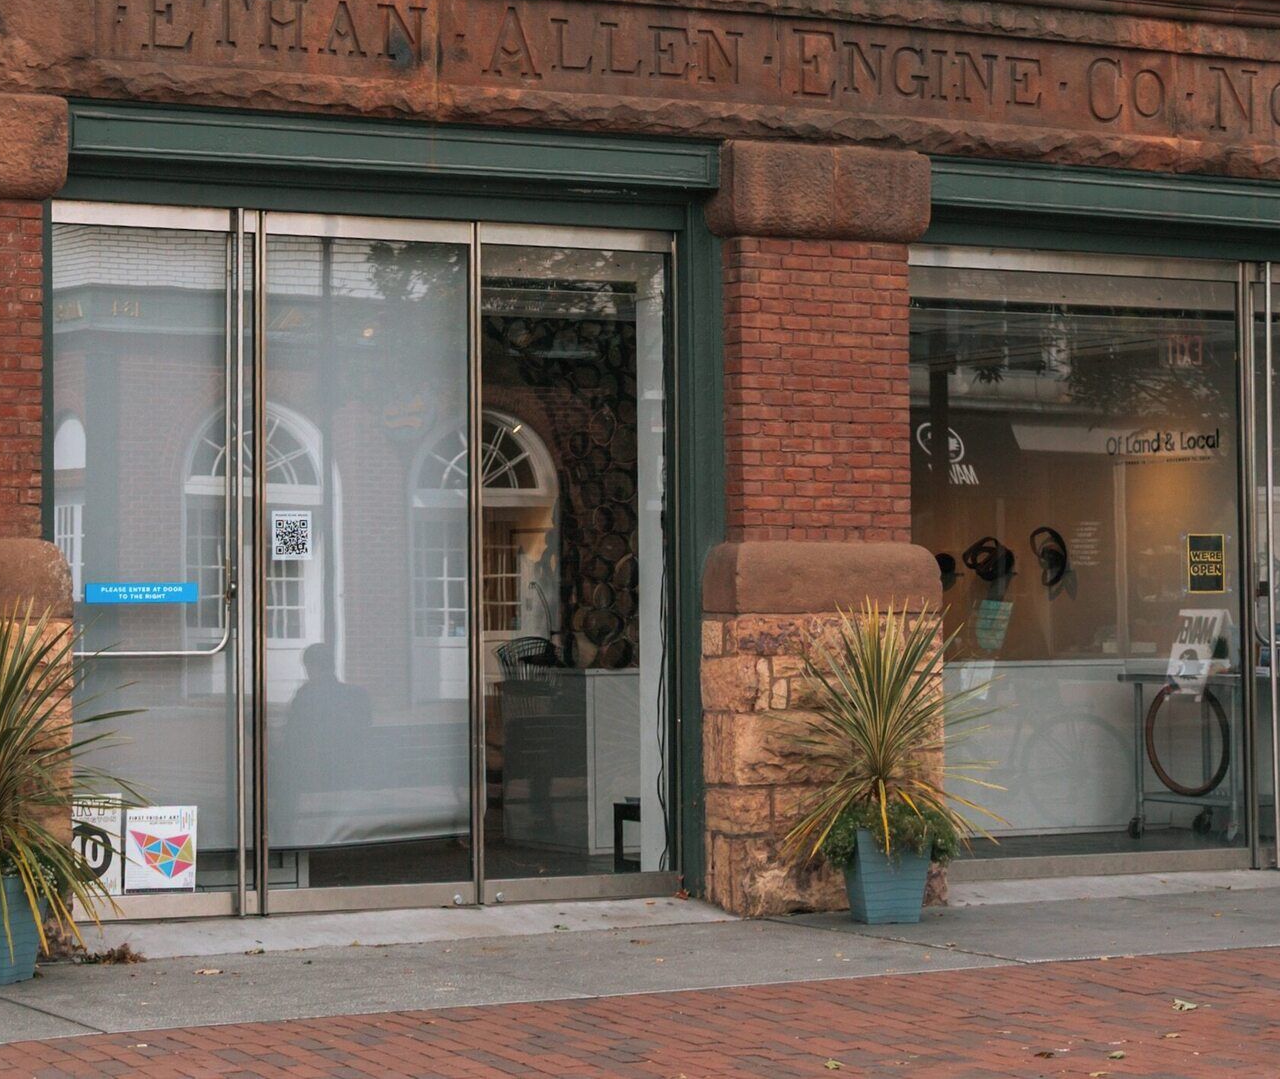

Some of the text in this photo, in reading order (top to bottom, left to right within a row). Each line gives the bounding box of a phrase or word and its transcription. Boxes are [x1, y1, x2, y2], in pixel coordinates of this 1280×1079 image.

[481, 6, 744, 85] ALLEN
[792, 28, 1043, 107] ENGINE
[1106, 427, 1220, 456] Of Land & Local
[1190, 550, 1223, 561] WE'RE
[1191, 563, 1223, 576] OPEN
[72, 799, 113, 817] RT
